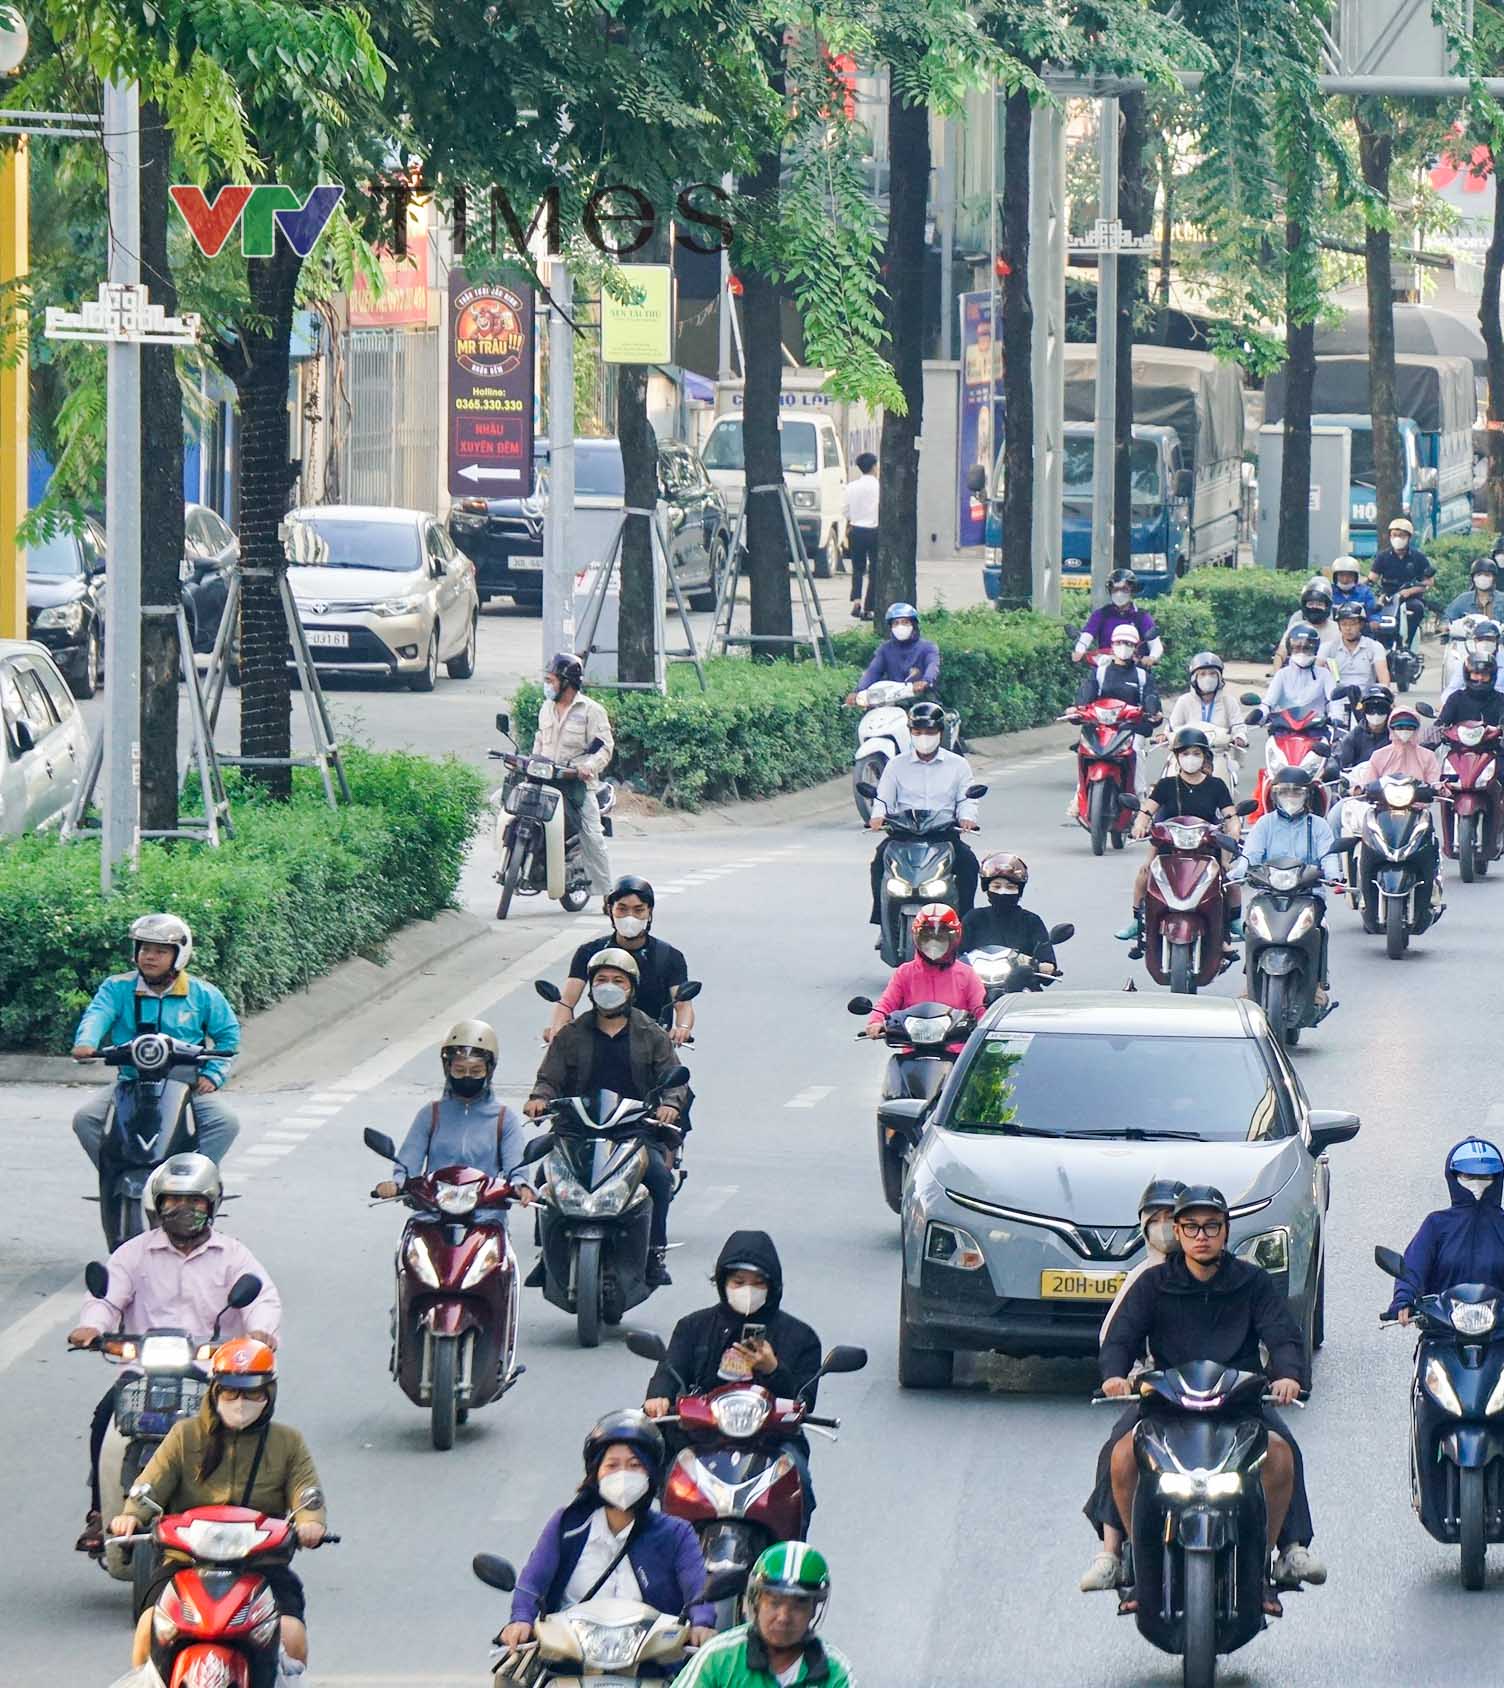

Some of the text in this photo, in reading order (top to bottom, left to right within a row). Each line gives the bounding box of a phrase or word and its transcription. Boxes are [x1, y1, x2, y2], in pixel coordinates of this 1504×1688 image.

[457, 339, 476, 355] MR
[472, 387, 506, 398] Hotline:
[455, 398, 523, 411] 0365.330.330
[1052, 1275, 1126, 1294] 20H-06
